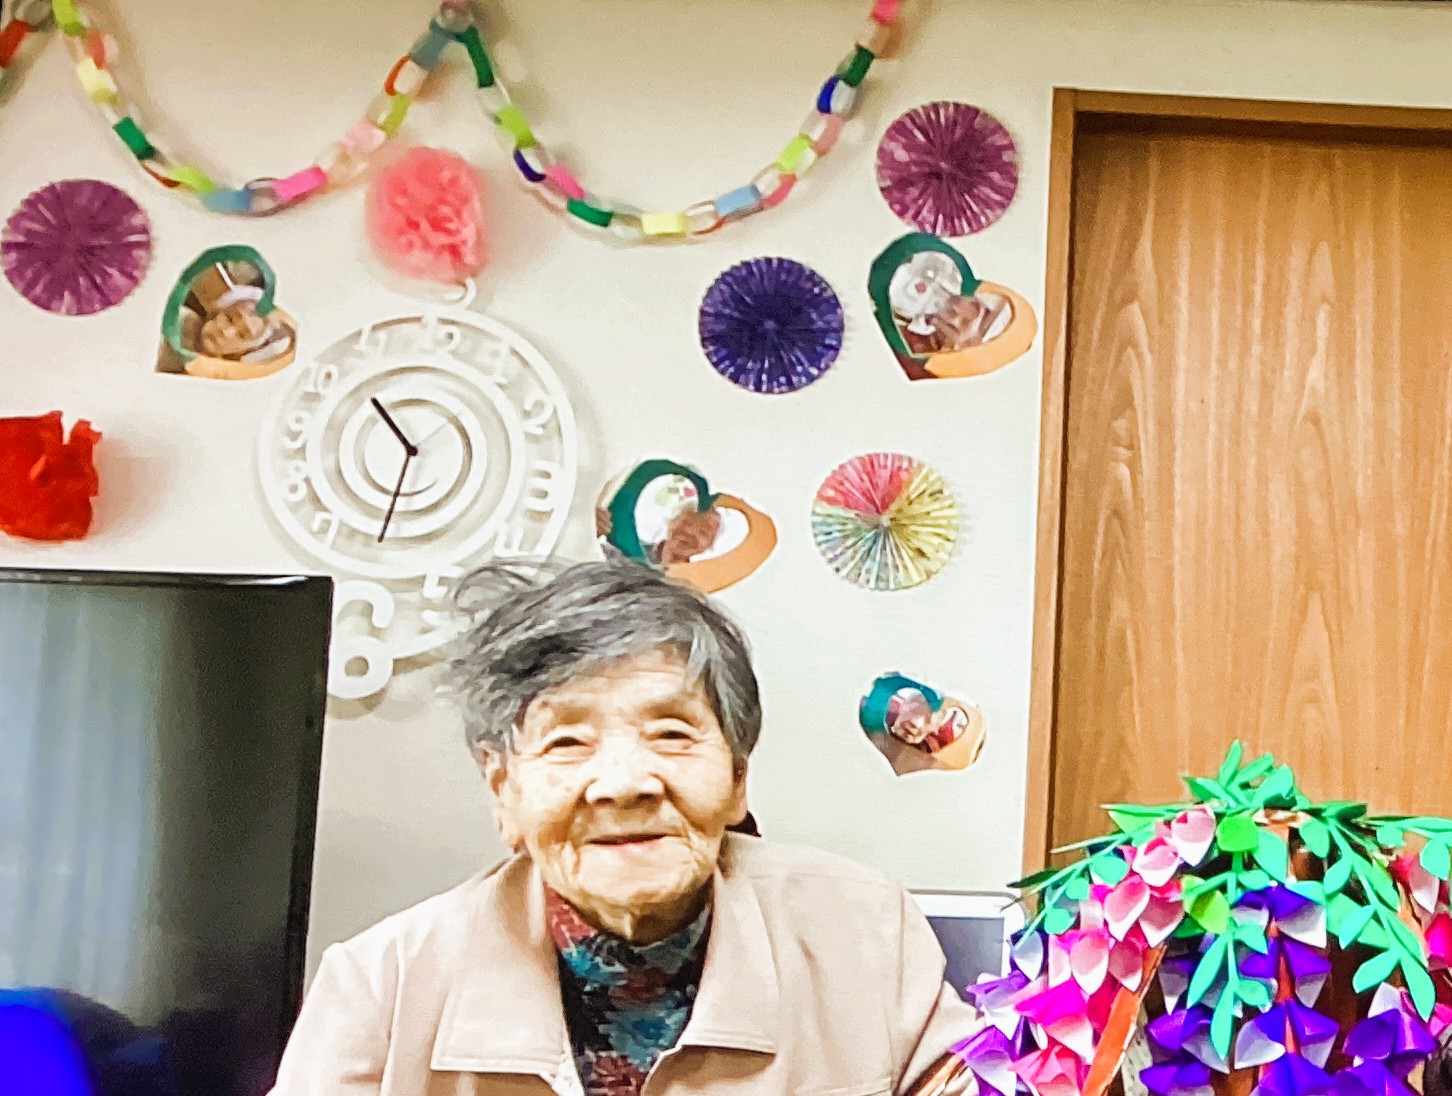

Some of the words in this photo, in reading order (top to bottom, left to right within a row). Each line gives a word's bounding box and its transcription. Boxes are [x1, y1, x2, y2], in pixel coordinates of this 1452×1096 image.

[354, 326, 388, 357] 11
[300, 363, 339, 393] 10
[281, 410, 313, 449] 9
[523, 396, 555, 437] 2
[281, 461, 309, 502] 8
[525, 461, 557, 512] 3
[311, 511, 341, 550] 7
[329, 580, 395, 700] 6
